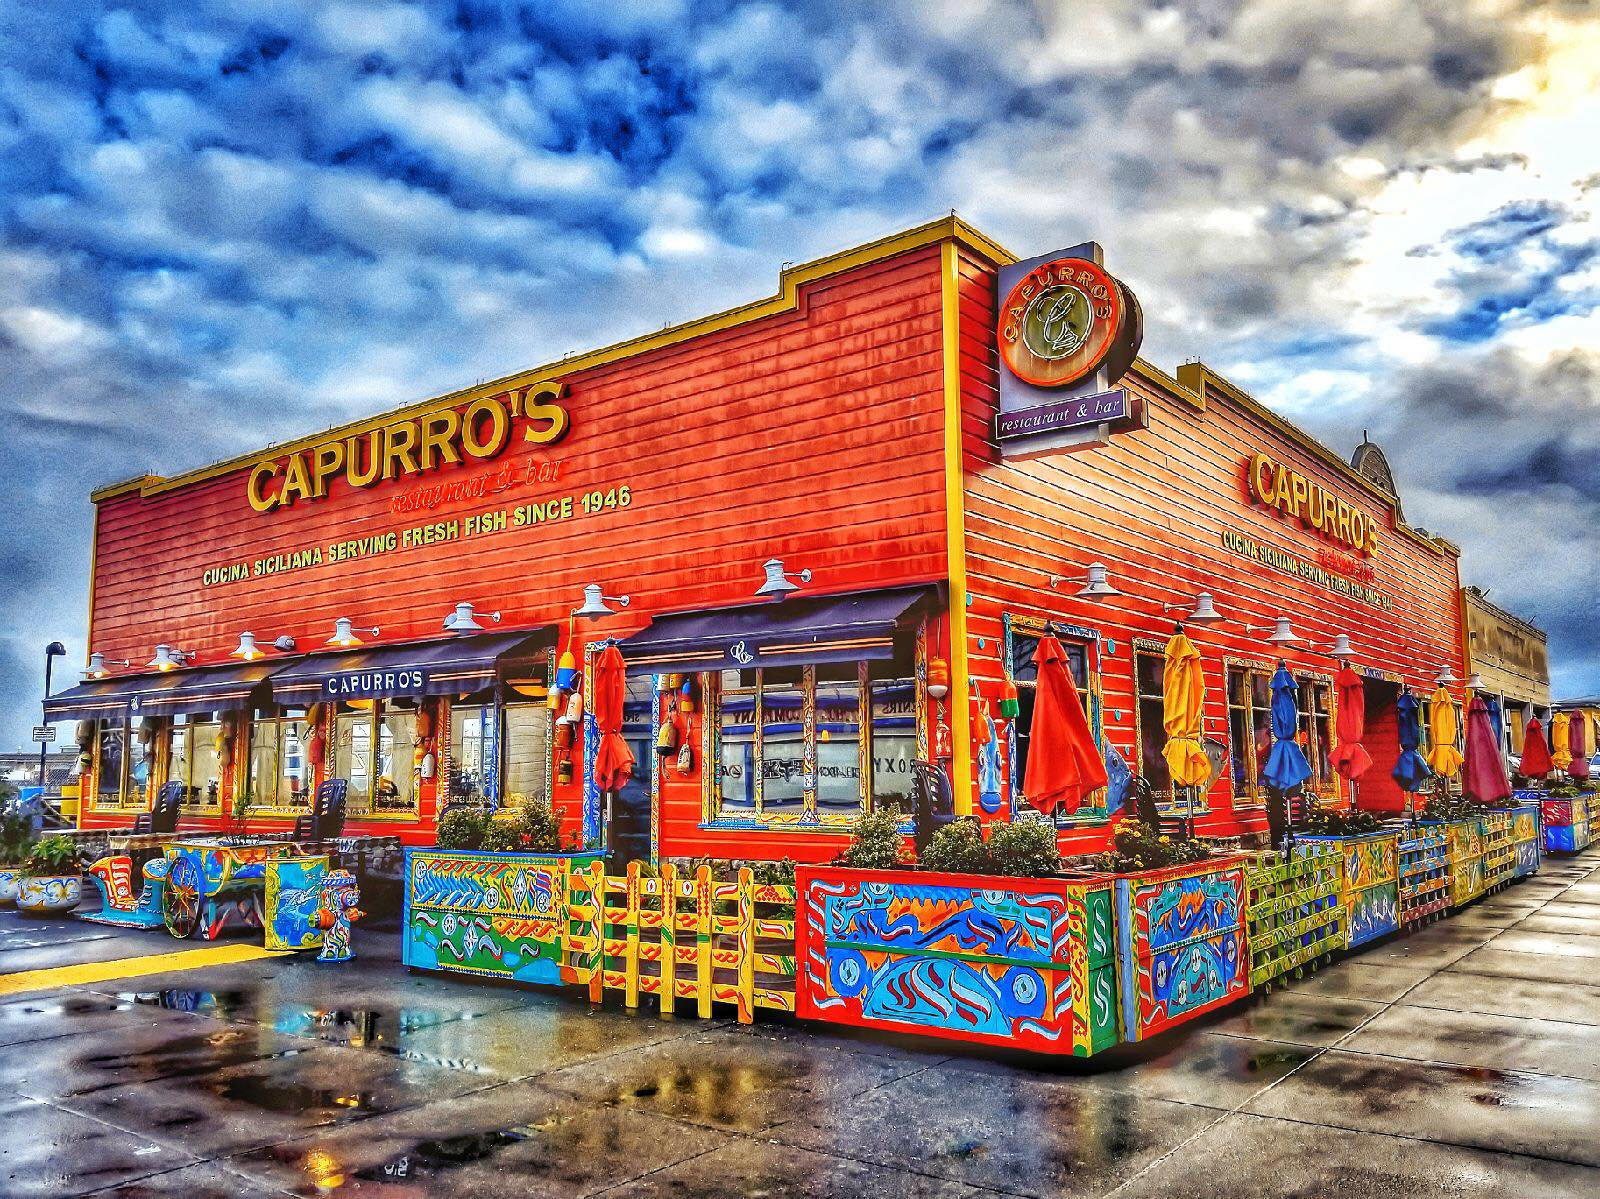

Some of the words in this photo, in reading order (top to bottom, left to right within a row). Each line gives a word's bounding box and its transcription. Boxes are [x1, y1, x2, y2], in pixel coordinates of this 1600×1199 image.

[1001, 408, 1070, 432] restaurant
[1076, 403, 1088, 418] &
[1094, 399, 1120, 415] bar
[247, 381, 569, 513] CAPURRO'S
[525, 458, 563, 486] bar
[1250, 453, 1379, 558] CAPURRO'S
[203, 562, 250, 586] CUCINA
[254, 547, 323, 577] SICILIANA
[328, 532, 397, 563] SERVING
[402, 519, 459, 549] FRESH
[464, 509, 508, 537] FISH
[513, 497, 573, 527] SINCE
[580, 485, 631, 515] 1946
[1222, 530, 1257, 561] CUCINA
[1259, 545, 1299, 575] SICILIANA
[1299, 562, 1330, 587] SERVING
[328, 670, 423, 694] CAPURRO'S
